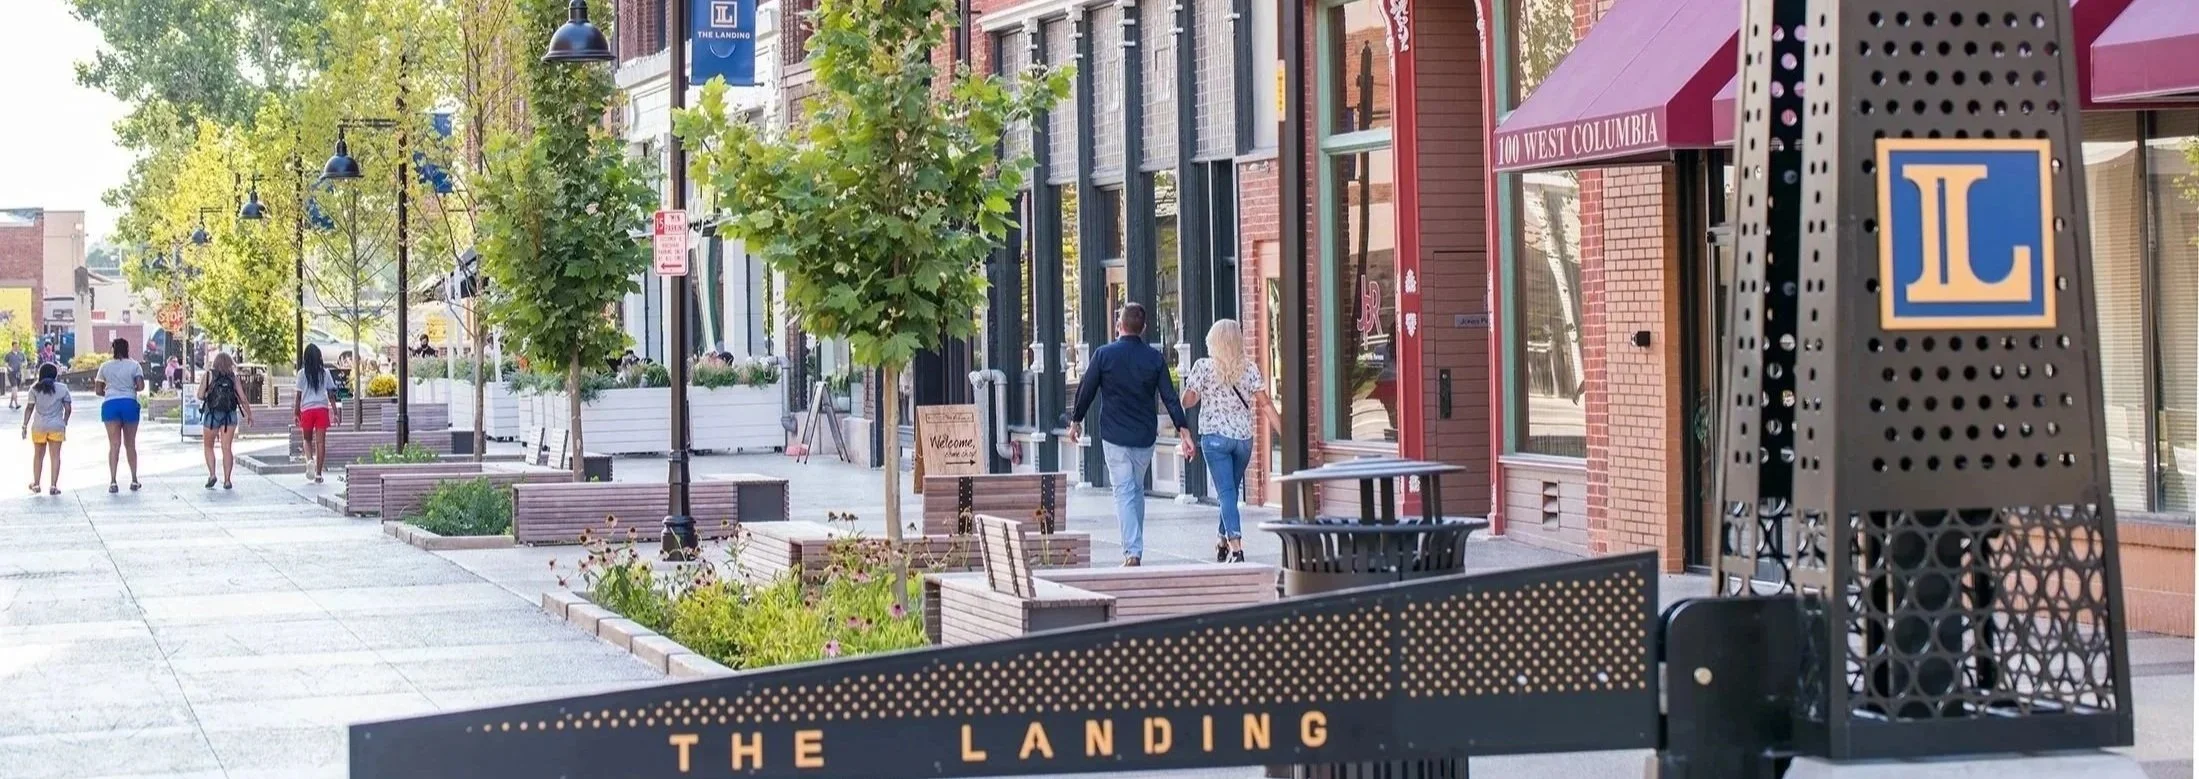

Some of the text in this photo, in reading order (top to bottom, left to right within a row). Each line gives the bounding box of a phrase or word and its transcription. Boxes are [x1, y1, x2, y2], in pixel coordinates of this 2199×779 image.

[697, 31, 750, 40] THE LANDING
[1498, 111, 1659, 165] 100 WEST COLUMBIA
[656, 217, 664, 230] 15
[159, 310, 184, 322] STOP
[670, 710, 1329, 772] THE LANDING
